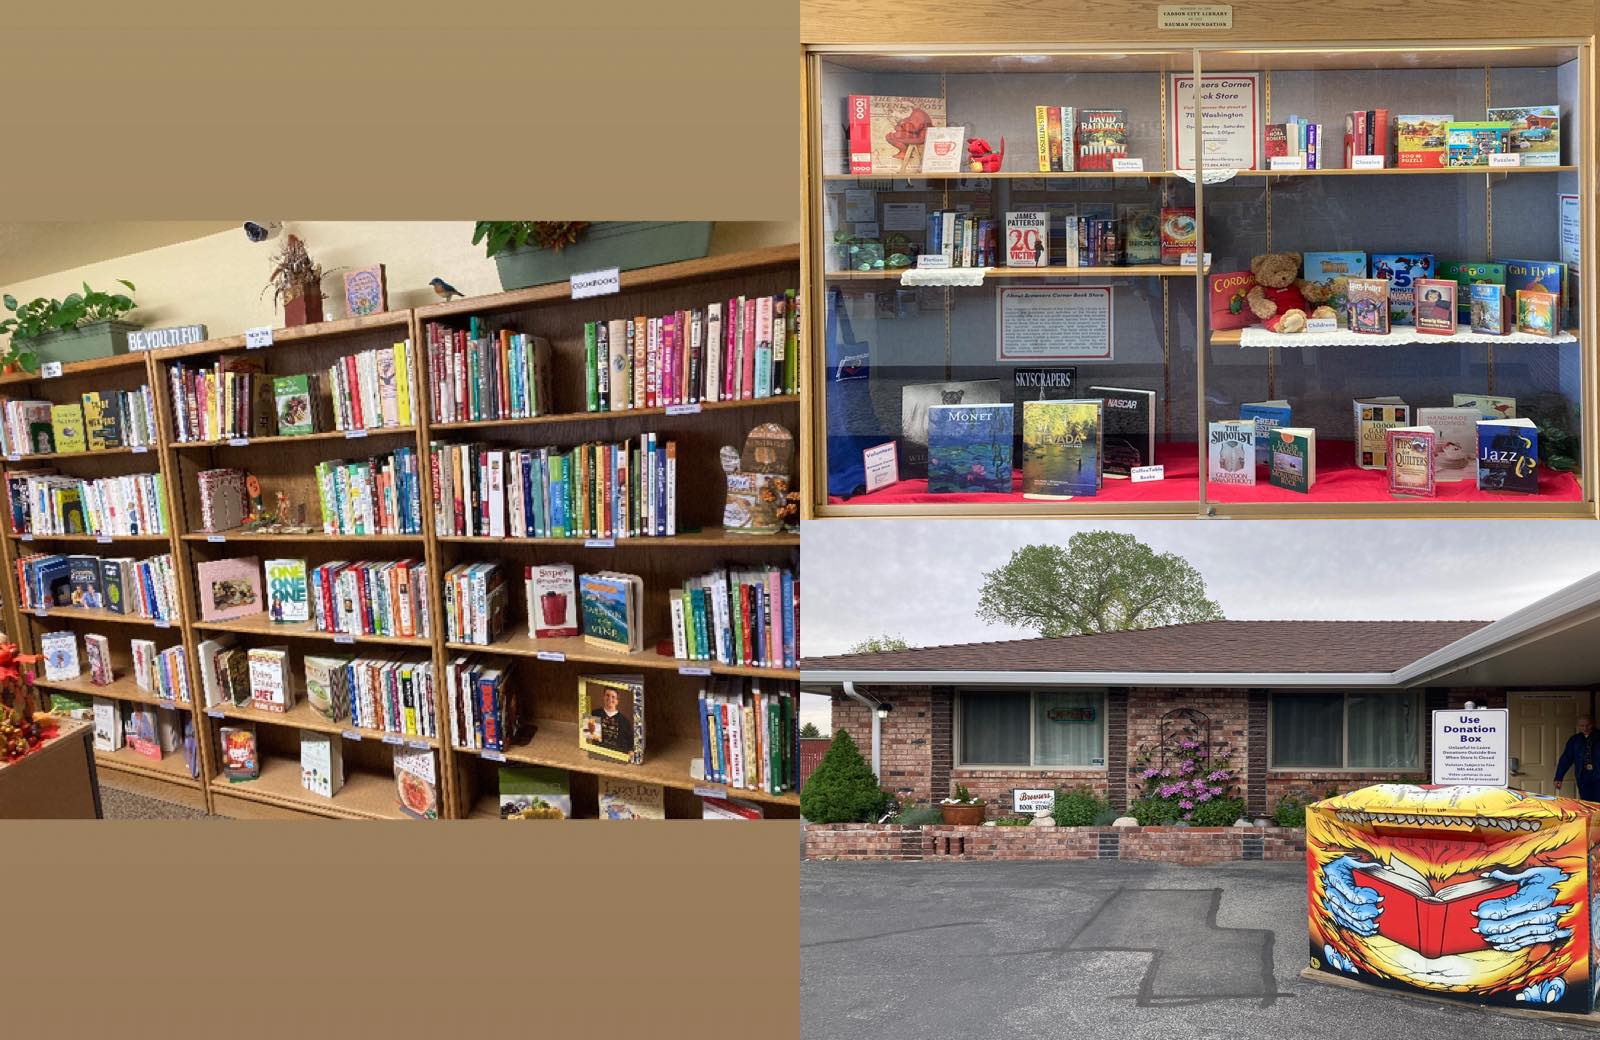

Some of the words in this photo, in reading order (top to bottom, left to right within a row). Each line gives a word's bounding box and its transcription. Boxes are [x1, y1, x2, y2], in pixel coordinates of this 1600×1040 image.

[1180, 81, 1219, 89] Brosers
[1215, 92, 1239, 100] Store
[1089, 115, 1116, 123] DAVID
[1081, 122, 1124, 130] BALDACCI
[1007, 219, 1044, 227] PATTERSON
[1508, 264, 1527, 275] Can
[572, 277, 618, 290] COOKBOOKS
[1394, 270, 1411, 287] 5
[636, 323, 645, 358] MARIO
[1015, 372, 1071, 387] SKYSCRAPERS
[635, 367, 645, 406] BATAL
[1107, 399, 1137, 409] NASCAR
[948, 412, 993, 422] MONET
[1253, 416, 1280, 425] GREAT
[1211, 431, 1253, 446] SHOOTIST
[1396, 439, 1412, 449] TIPS
[1395, 452, 1428, 467] QUILTERS
[1480, 447, 1518, 462] Jazz
[539, 568, 568, 578] Super
[271, 577, 305, 590] ONE
[272, 590, 306, 602] ONE
[1460, 715, 1480, 724] Use
[1444, 725, 1496, 733] Donation
[1460, 735, 1482, 743] Box
